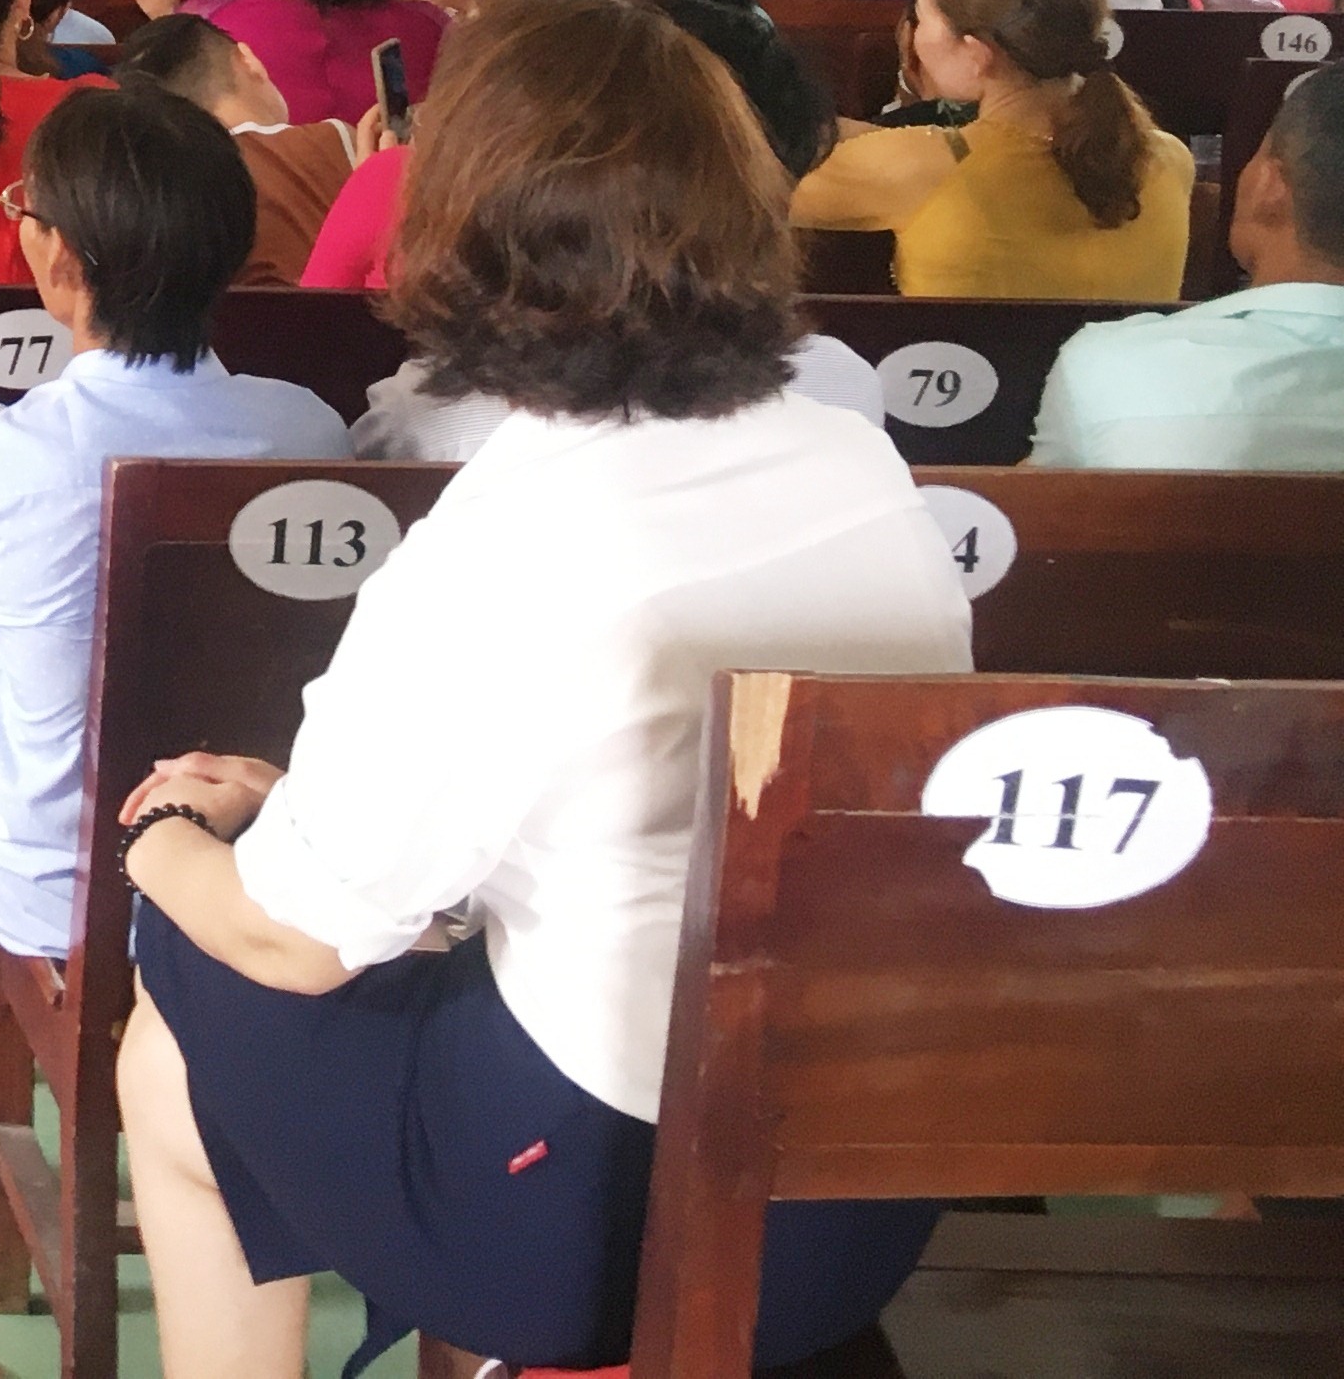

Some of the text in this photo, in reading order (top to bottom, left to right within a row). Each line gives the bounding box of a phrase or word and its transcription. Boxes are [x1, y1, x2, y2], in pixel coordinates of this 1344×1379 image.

[1276, 32, 1318, 54] 146
[0, 335, 53, 375] 77
[908, 369, 962, 409] 79
[267, 518, 367, 567] 113
[984, 768, 1163, 855] 117
